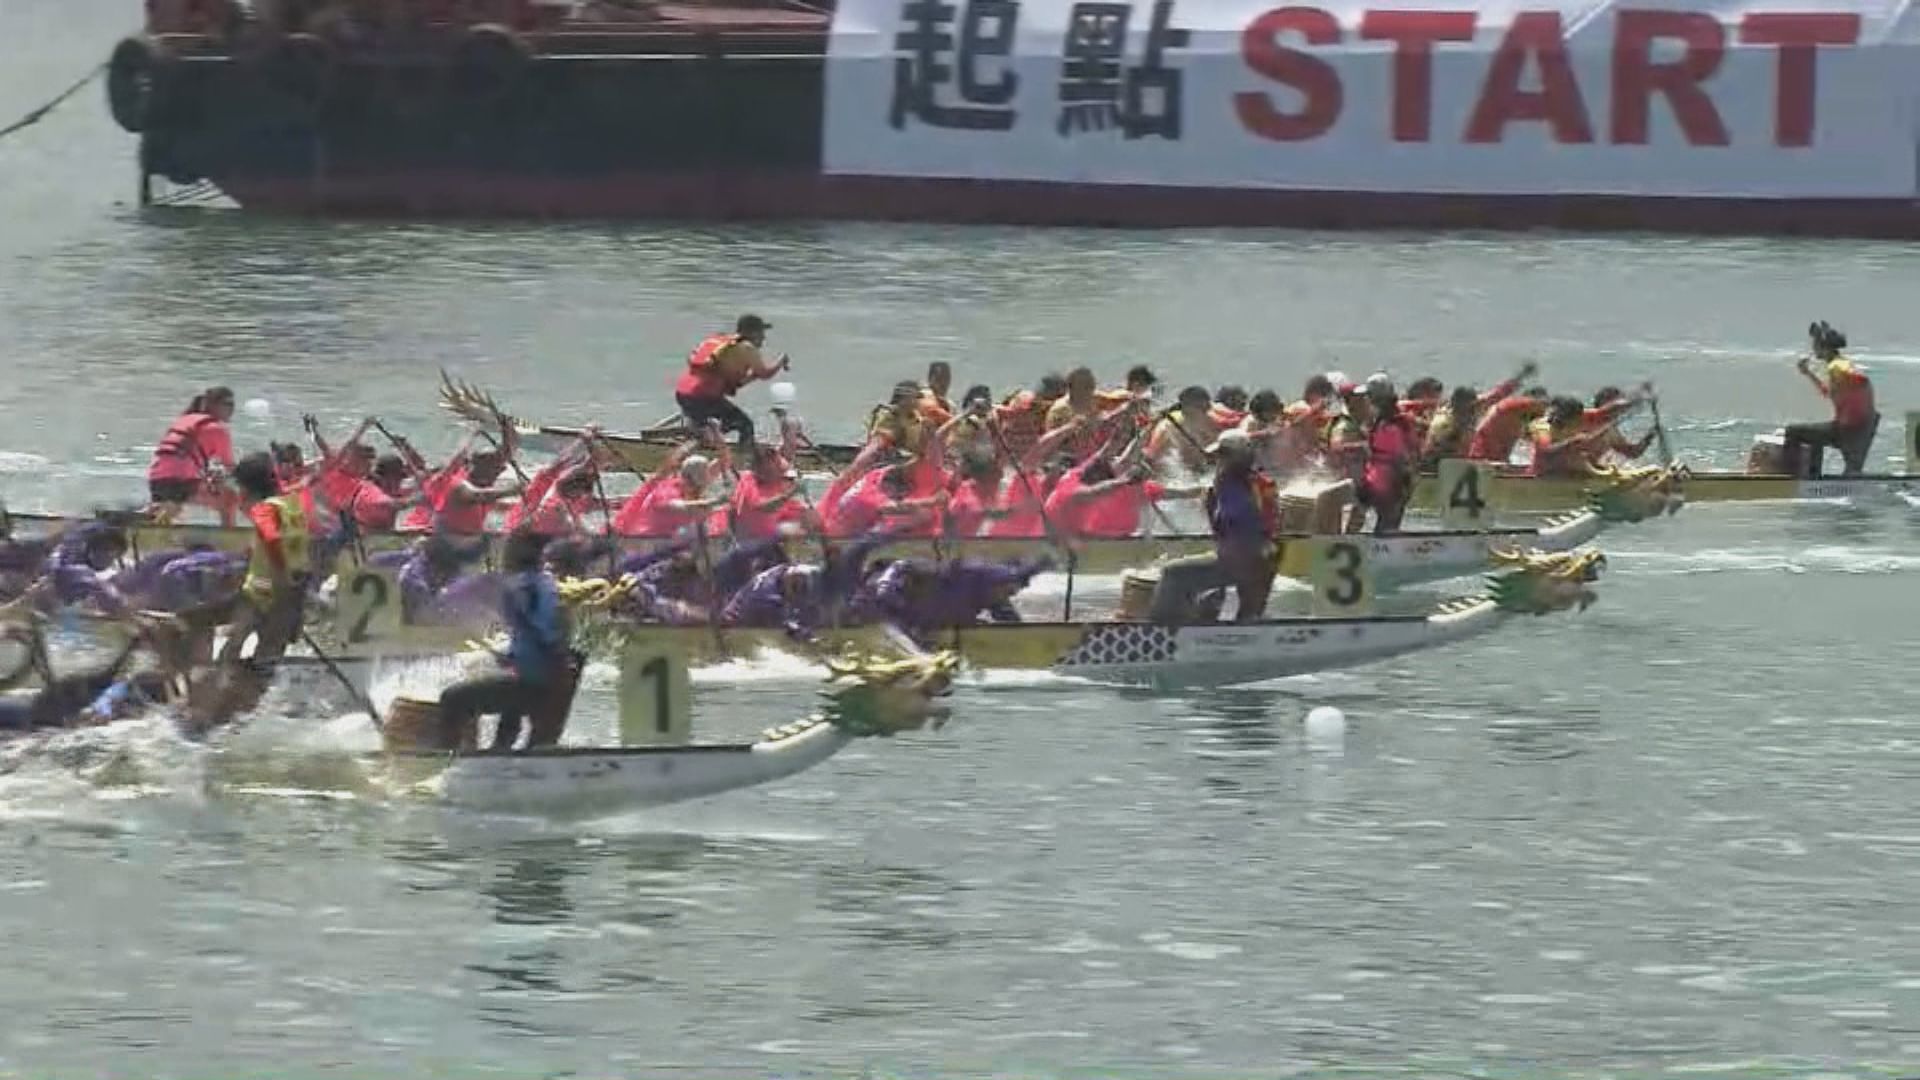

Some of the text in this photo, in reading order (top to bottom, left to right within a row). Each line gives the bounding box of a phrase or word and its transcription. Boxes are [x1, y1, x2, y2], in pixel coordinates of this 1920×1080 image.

[890, 0, 1191, 140] 起點
[1232, 6, 1861, 147] START
[1450, 465, 1485, 518] 4
[351, 573, 388, 643] 2
[1325, 543, 1363, 606] 3
[641, 656, 670, 733] 1
